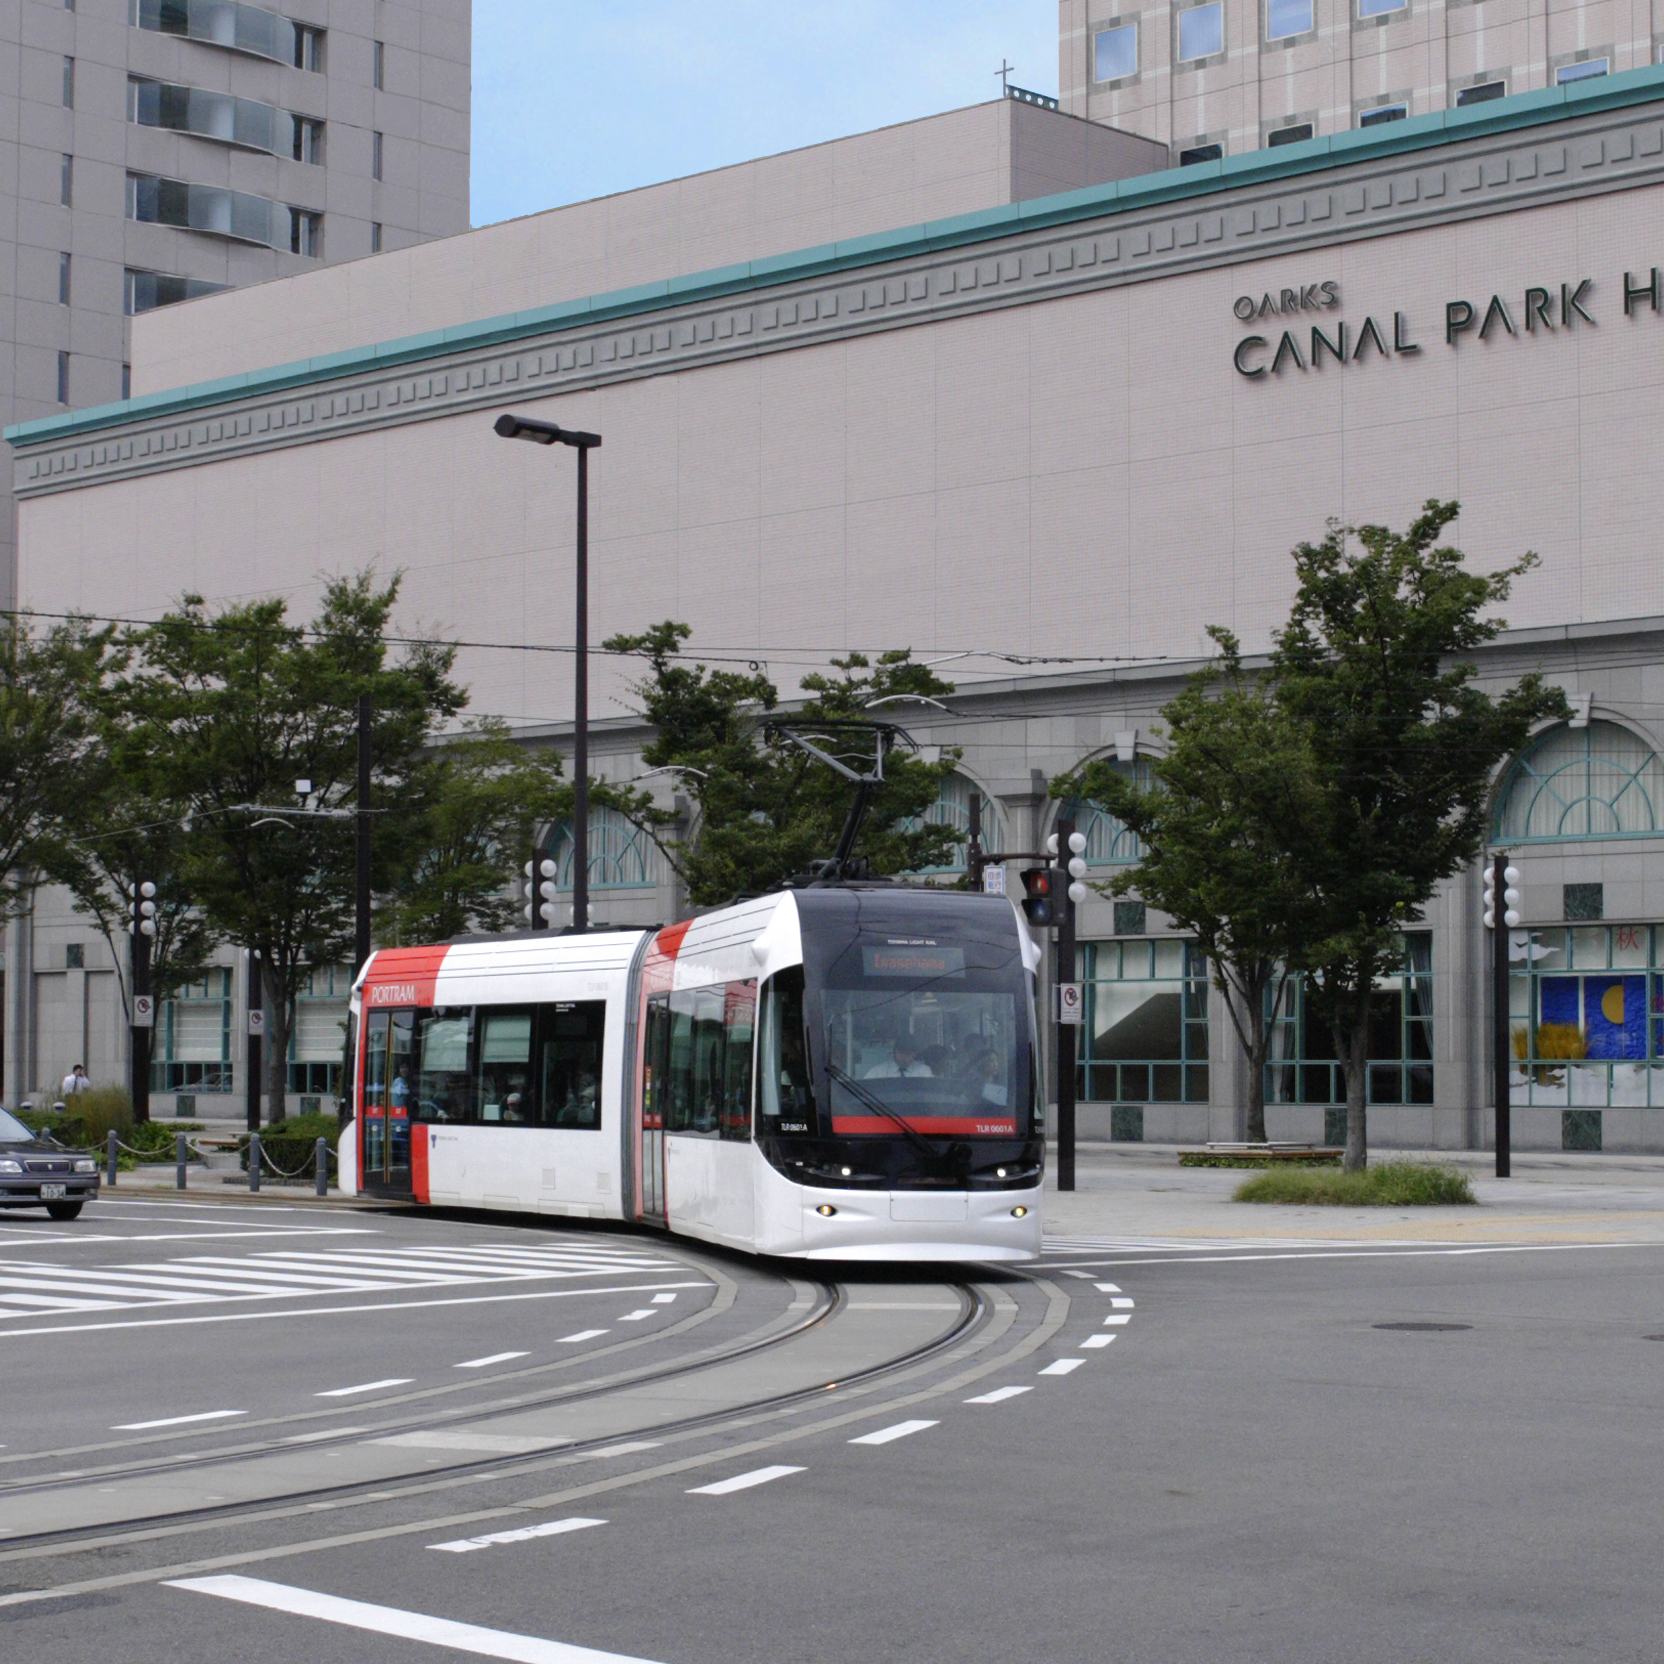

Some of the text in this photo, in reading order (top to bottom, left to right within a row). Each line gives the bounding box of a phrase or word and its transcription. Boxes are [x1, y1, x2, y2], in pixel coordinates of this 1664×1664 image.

[1233, 281, 1336, 320] OARKS
[1233, 311, 1420, 377] CANAL
[1446, 279, 1594, 344] PARK
[1616, 926, 1640, 951] 秋
[371, 984, 415, 1004] PORTRAM
[977, 1124, 1013, 1133] TLR 0601A
